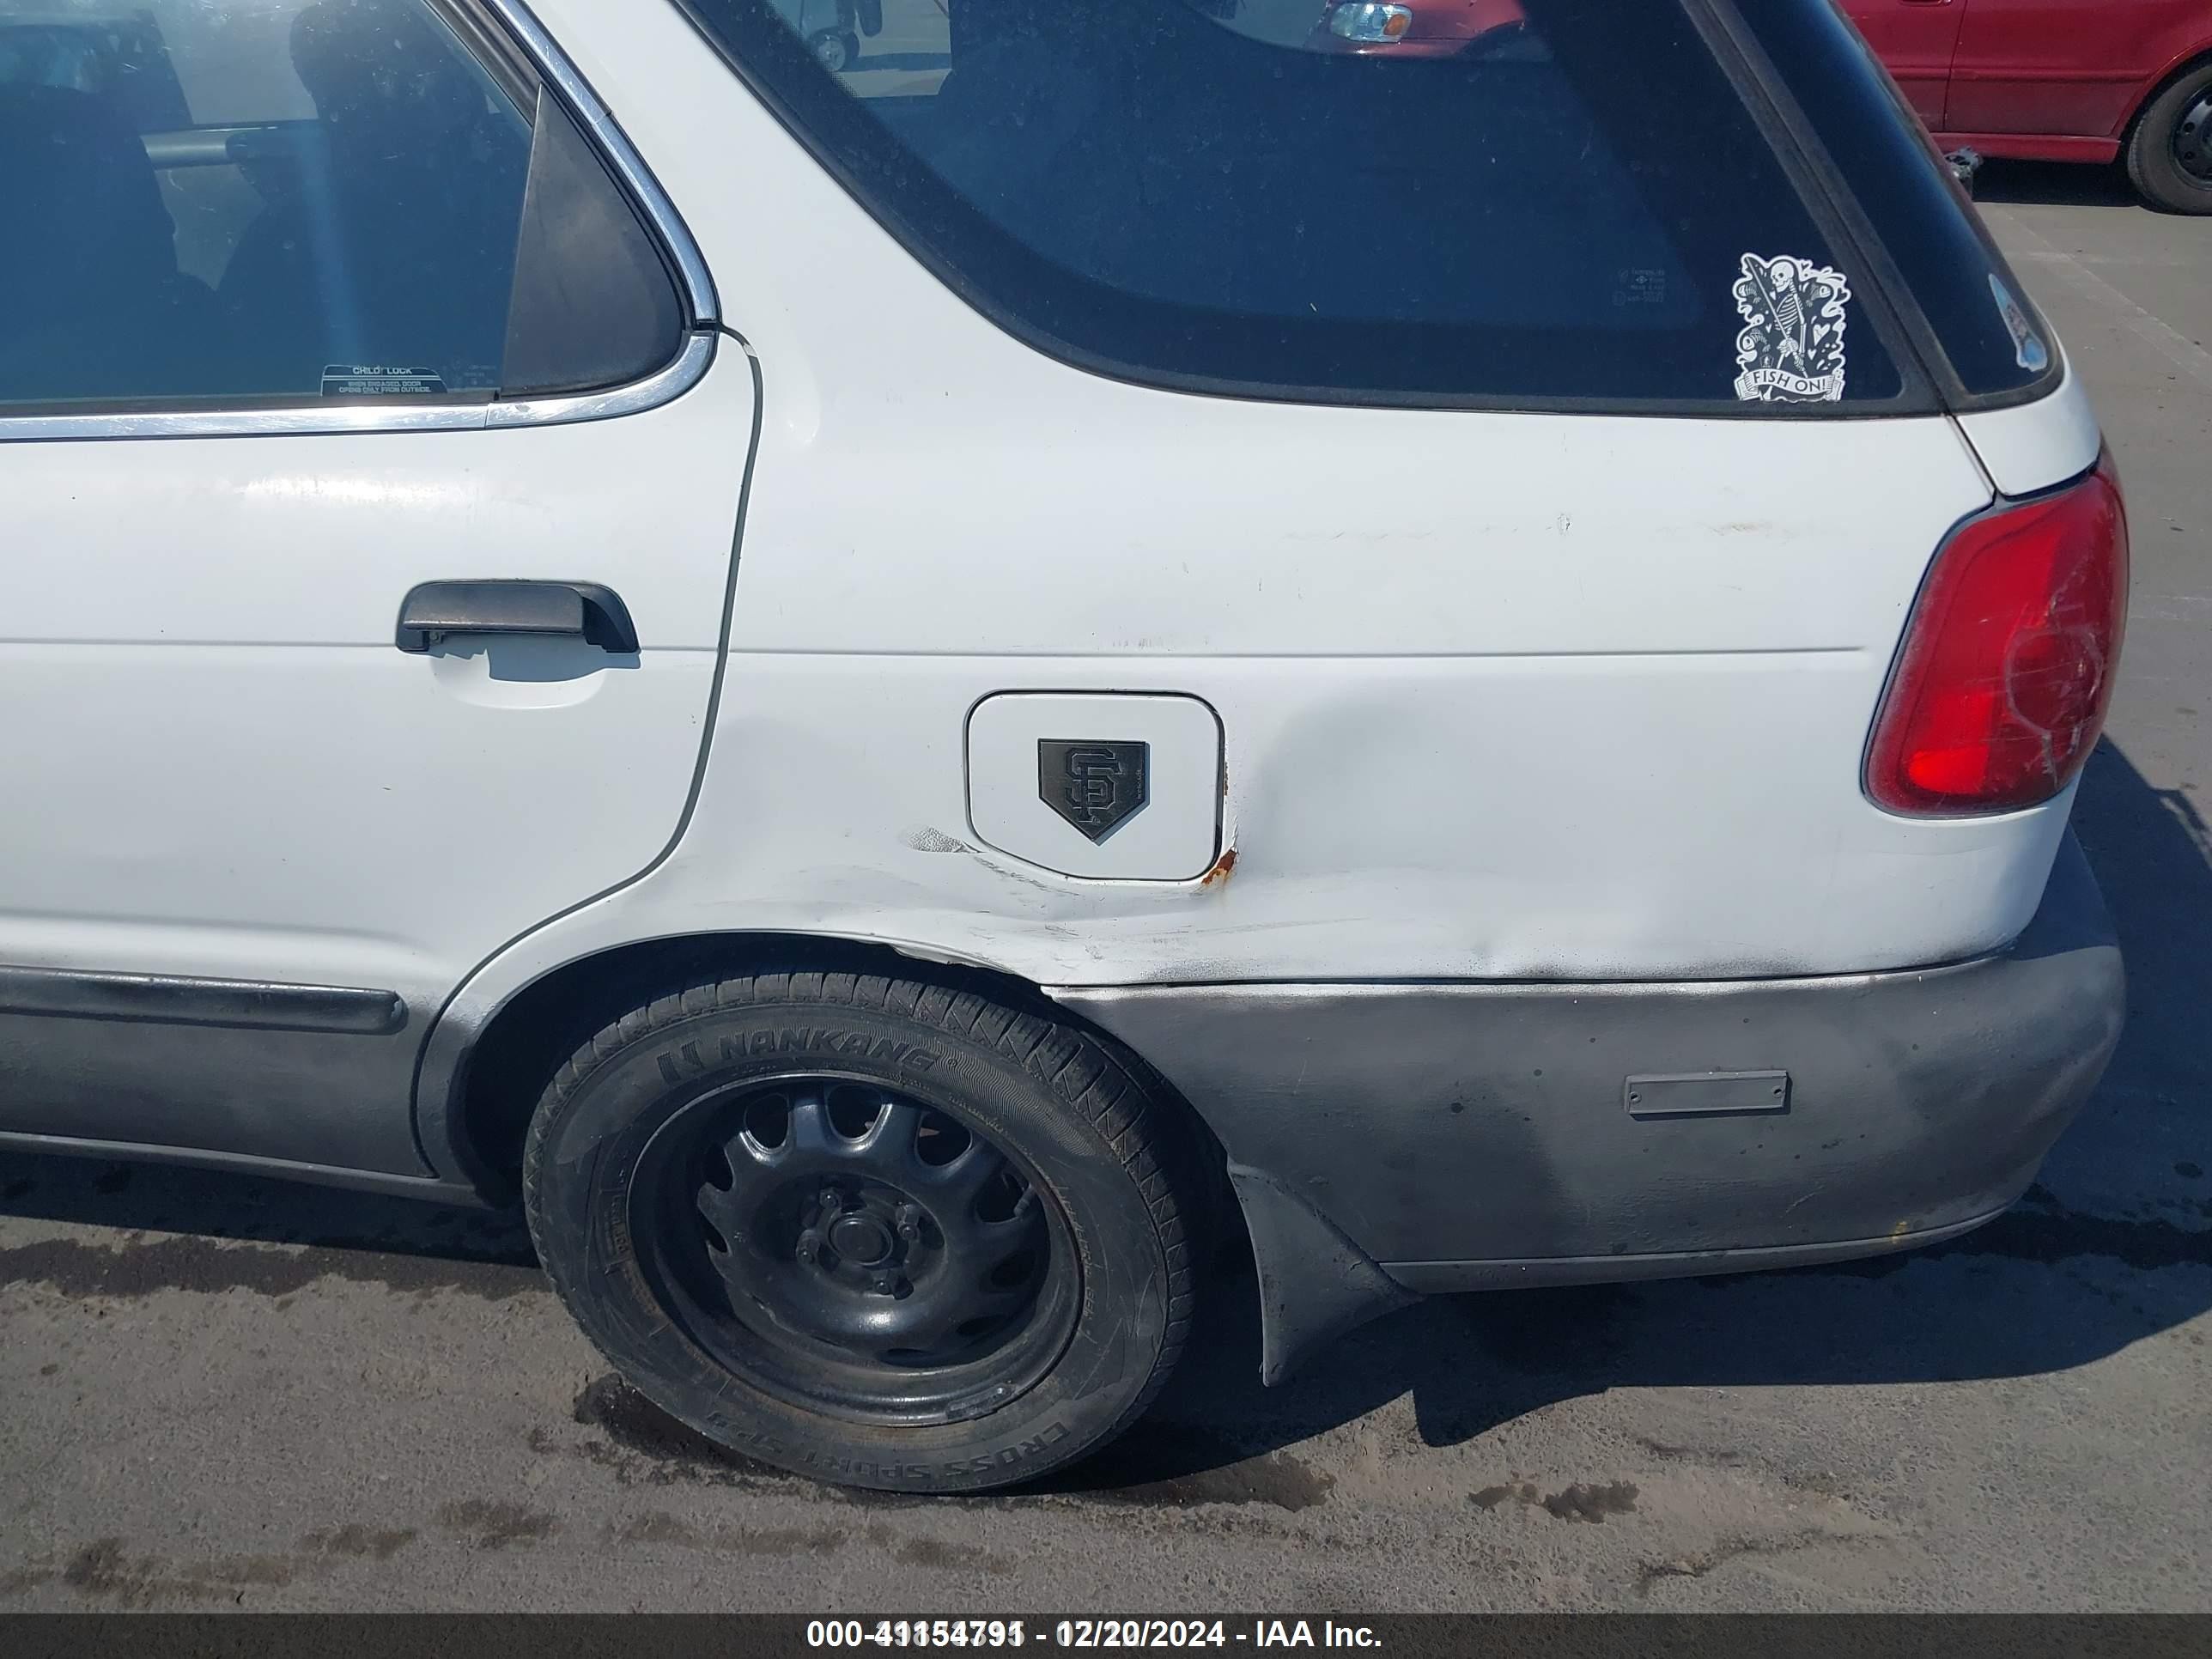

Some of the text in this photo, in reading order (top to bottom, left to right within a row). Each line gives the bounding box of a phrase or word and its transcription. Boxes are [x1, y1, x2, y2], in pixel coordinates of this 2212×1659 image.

[1753, 371, 1826, 392] FISH ON!
[718, 1027, 938, 1073] NANKANG
[945, 1421, 1071, 1476] CROSS
